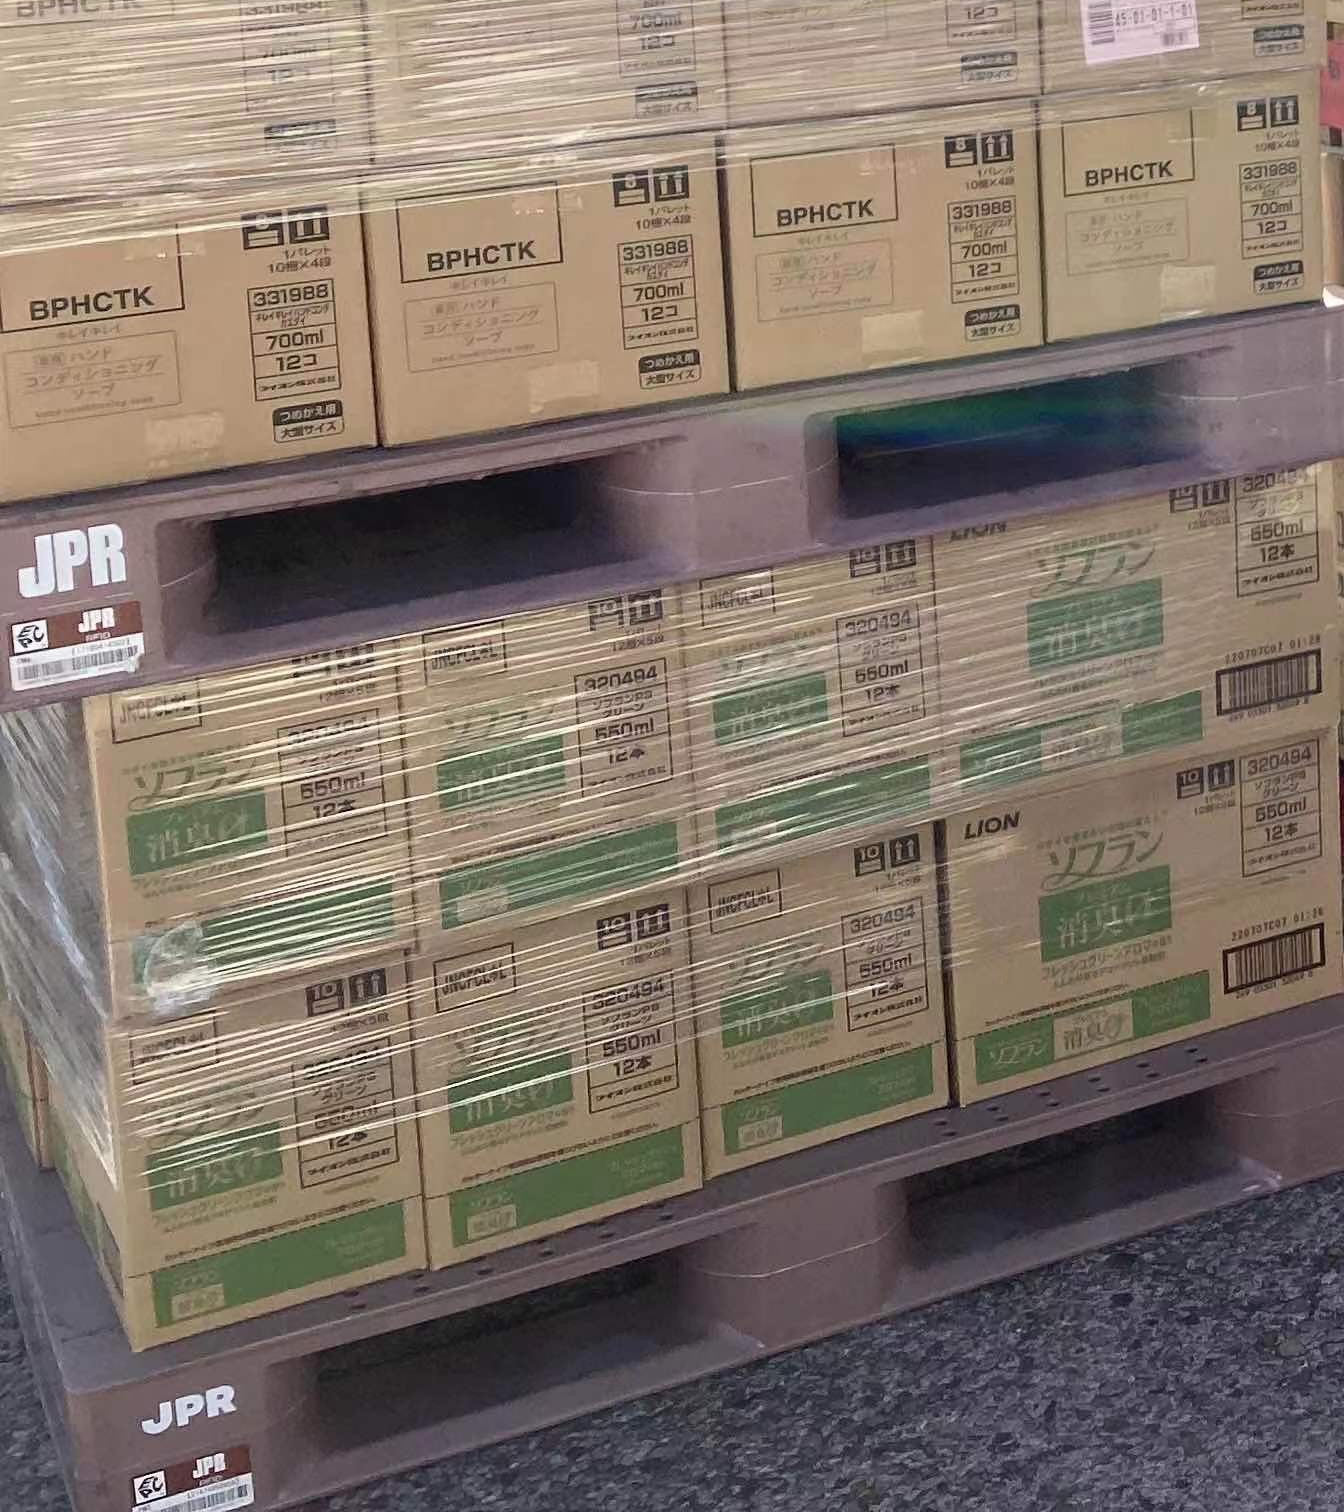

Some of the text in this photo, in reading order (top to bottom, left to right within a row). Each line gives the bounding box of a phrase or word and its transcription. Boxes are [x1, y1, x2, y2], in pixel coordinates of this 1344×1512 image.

[1085, 160, 1174, 187] BPHCTK
[776, 199, 875, 228] BPHCTK
[951, 199, 1012, 219] 331988
[427, 240, 536, 272] BPHCTK
[29, 286, 154, 322] BPHCTK
[253, 284, 329, 307] 331988
[265, 331, 324, 351] 700ml
[18, 523, 127, 598] JPR
[79, 608, 116, 633] JPR
[964, 810, 1021, 841] LION
[141, 1385, 237, 1435] JPR
[193, 1453, 226, 1479] JPR
